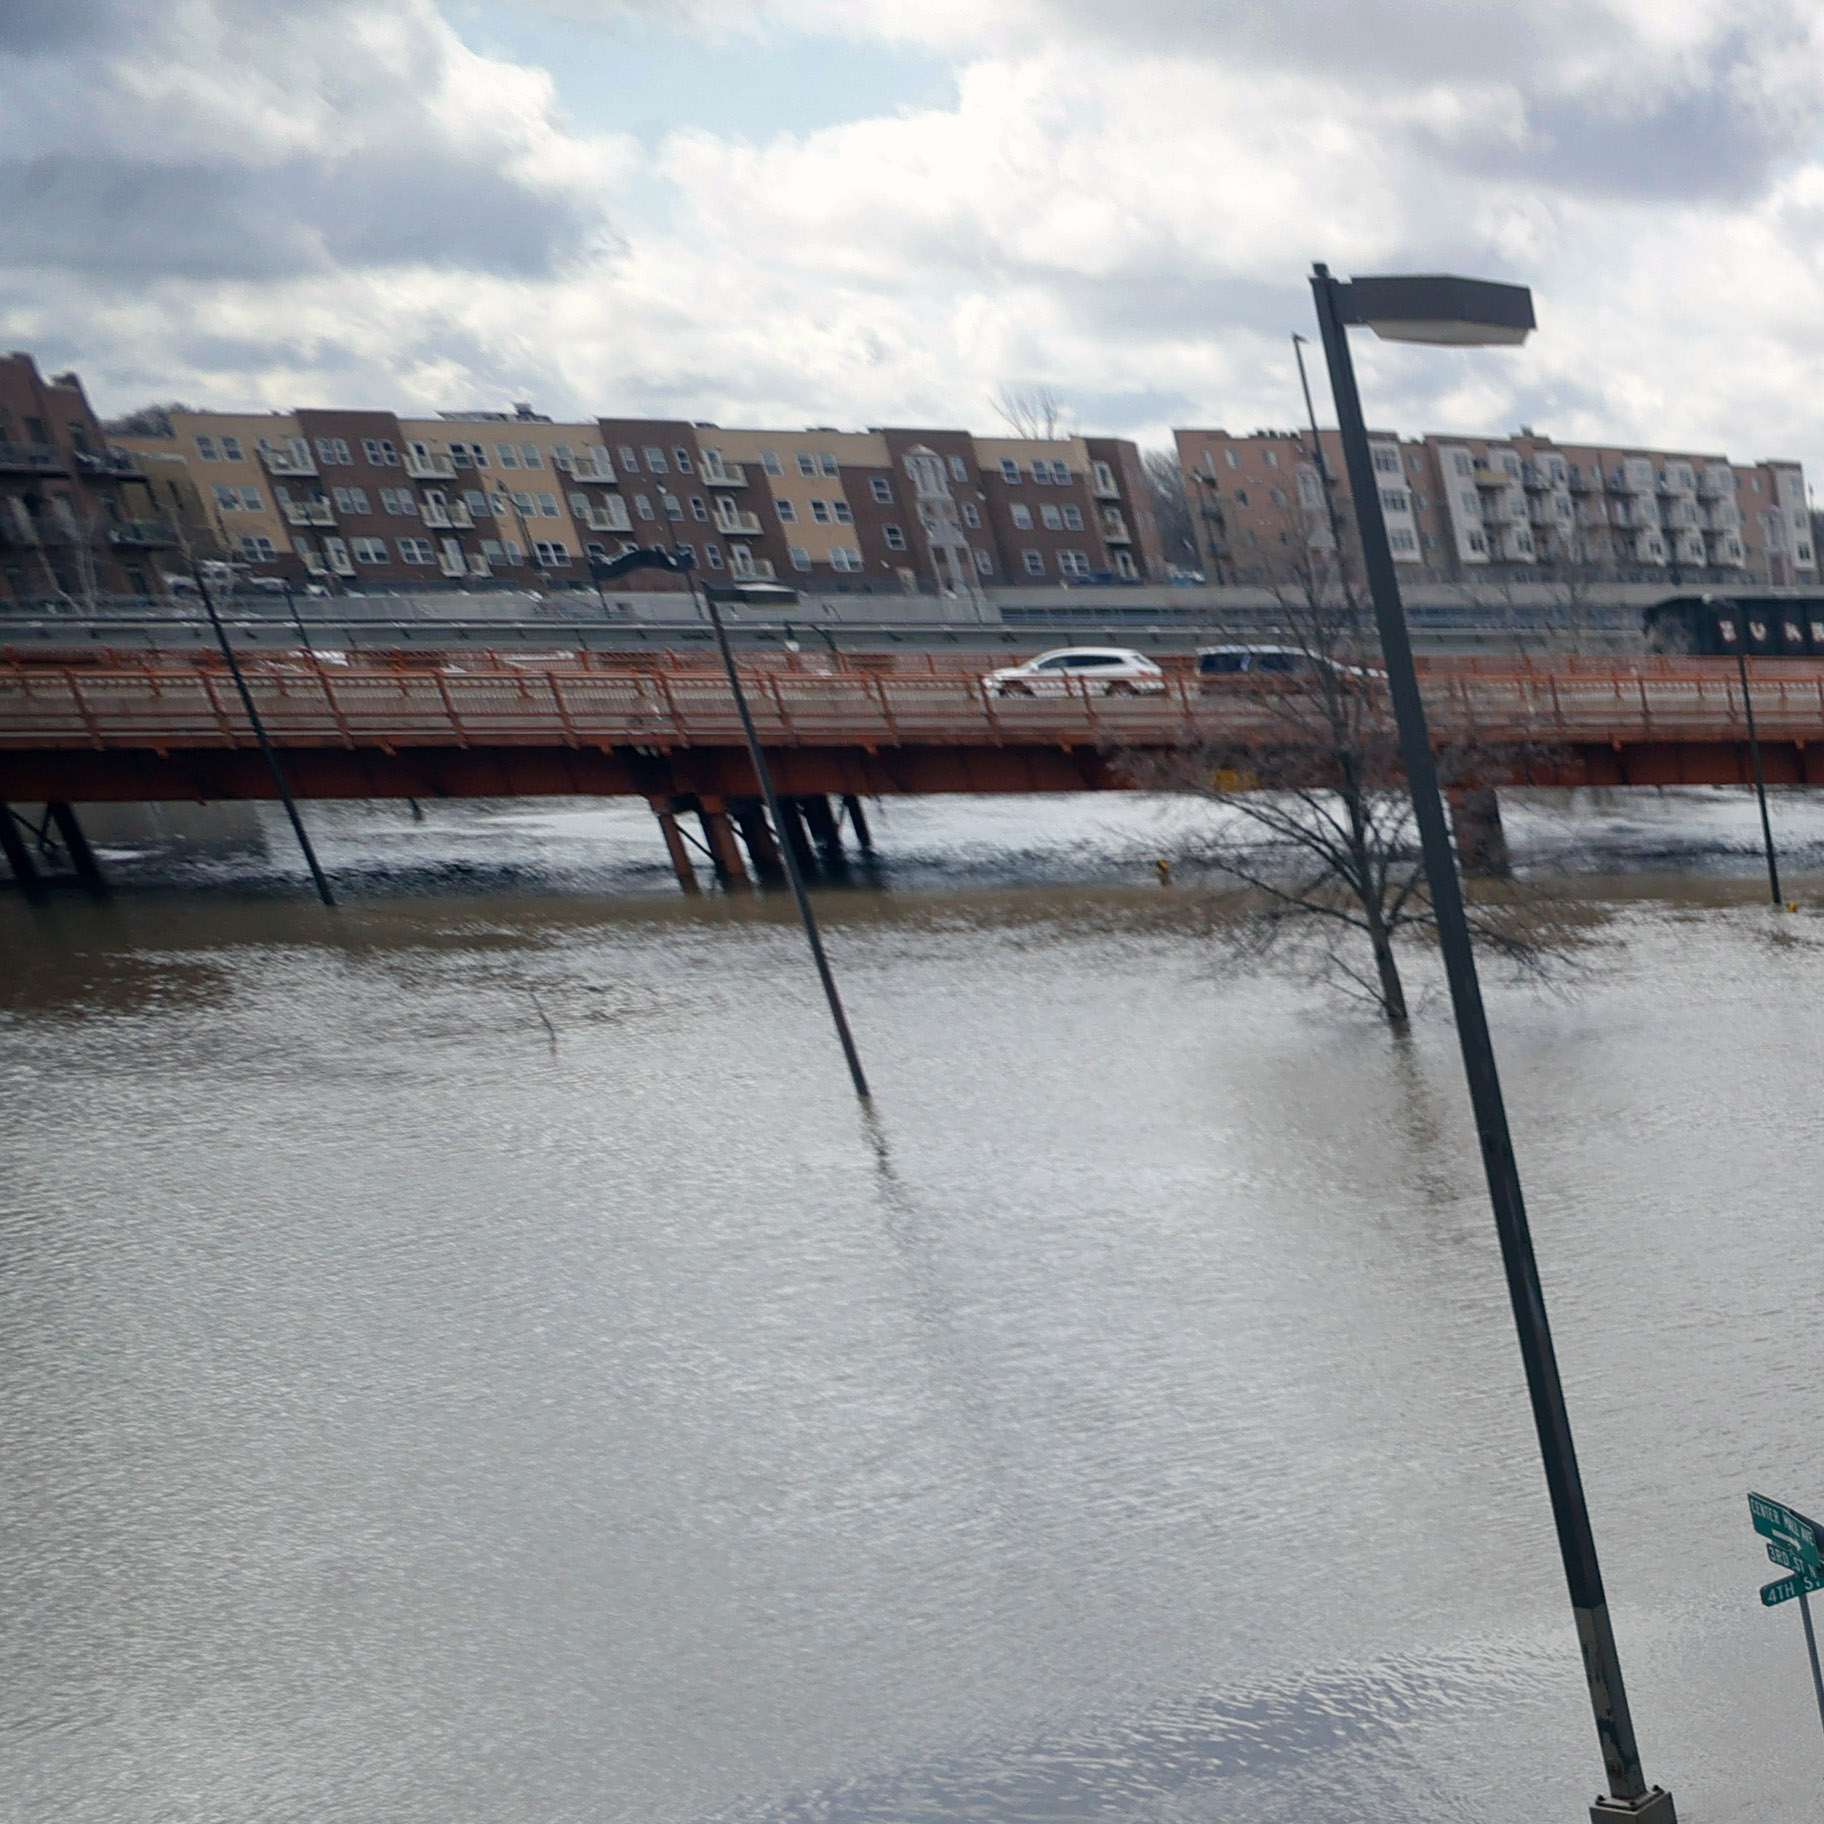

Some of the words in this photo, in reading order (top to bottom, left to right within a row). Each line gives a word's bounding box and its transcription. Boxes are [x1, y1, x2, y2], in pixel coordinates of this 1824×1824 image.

[1750, 1497, 1780, 1525] CENTER
[1801, 1526, 1815, 1547] AVE
[1768, 1546, 1790, 1567] 3RD
[1792, 1556, 1805, 1574] ST
[1766, 1581, 1796, 1602] 4TH
